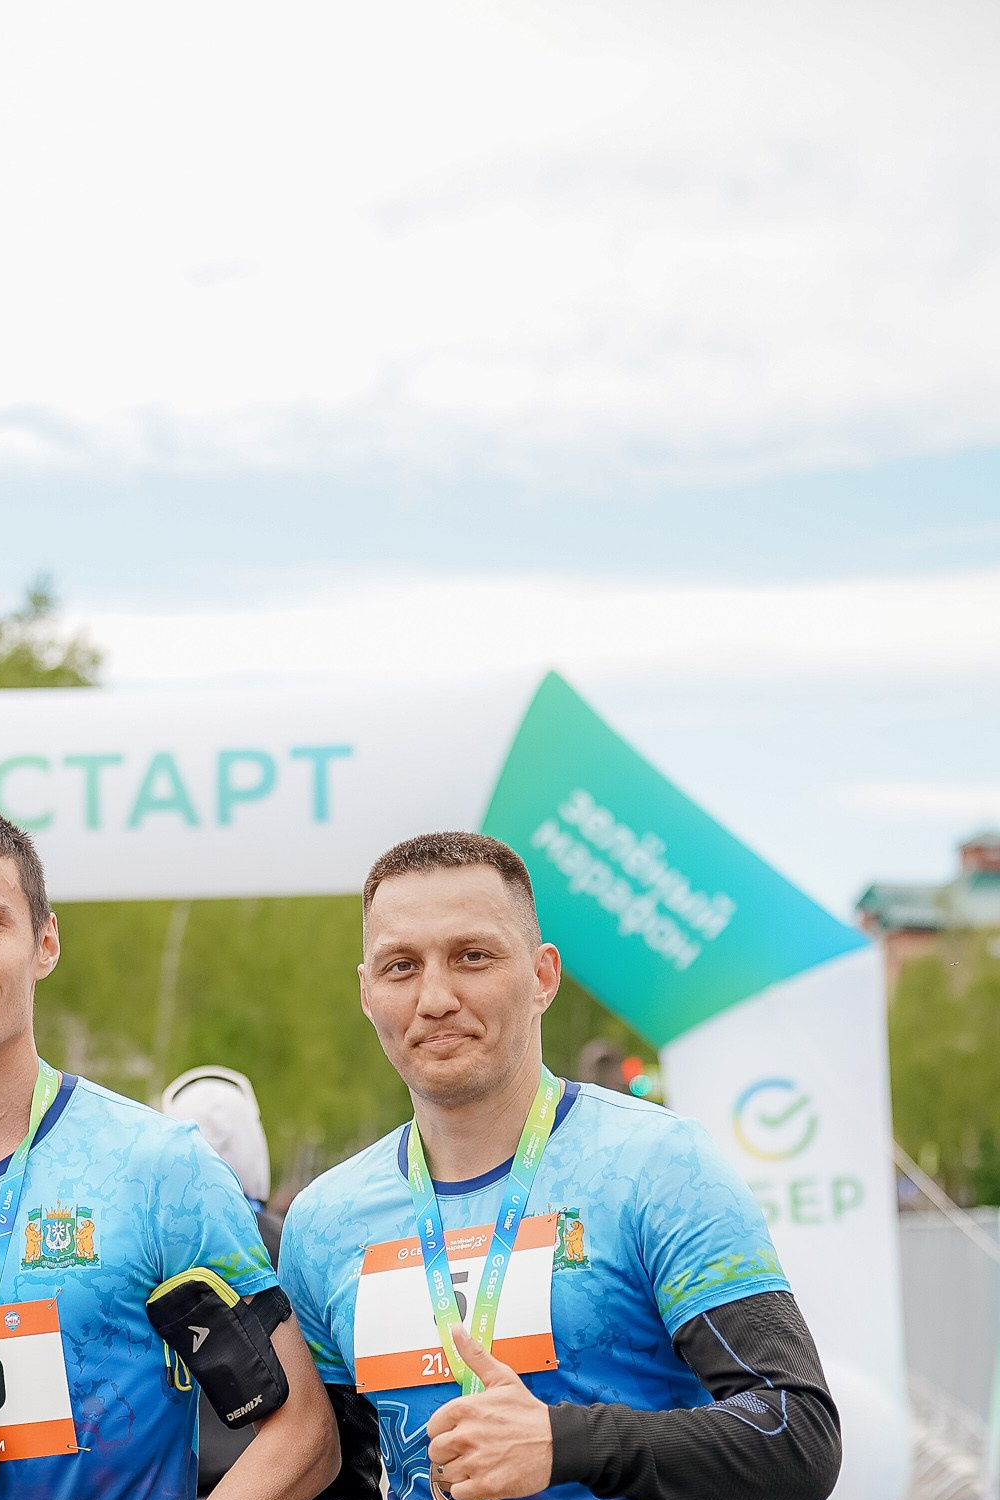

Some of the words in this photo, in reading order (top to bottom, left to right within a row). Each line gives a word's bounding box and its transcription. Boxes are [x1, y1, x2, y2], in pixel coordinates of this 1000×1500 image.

[747, 1174, 865, 1227] БЕР
[504, 1208, 517, 1231] Utair
[433, 1270, 446, 1297] СБЕР
[486, 1270, 499, 1299] СБЕР
[226, 1394, 263, 1422] DEMIX
